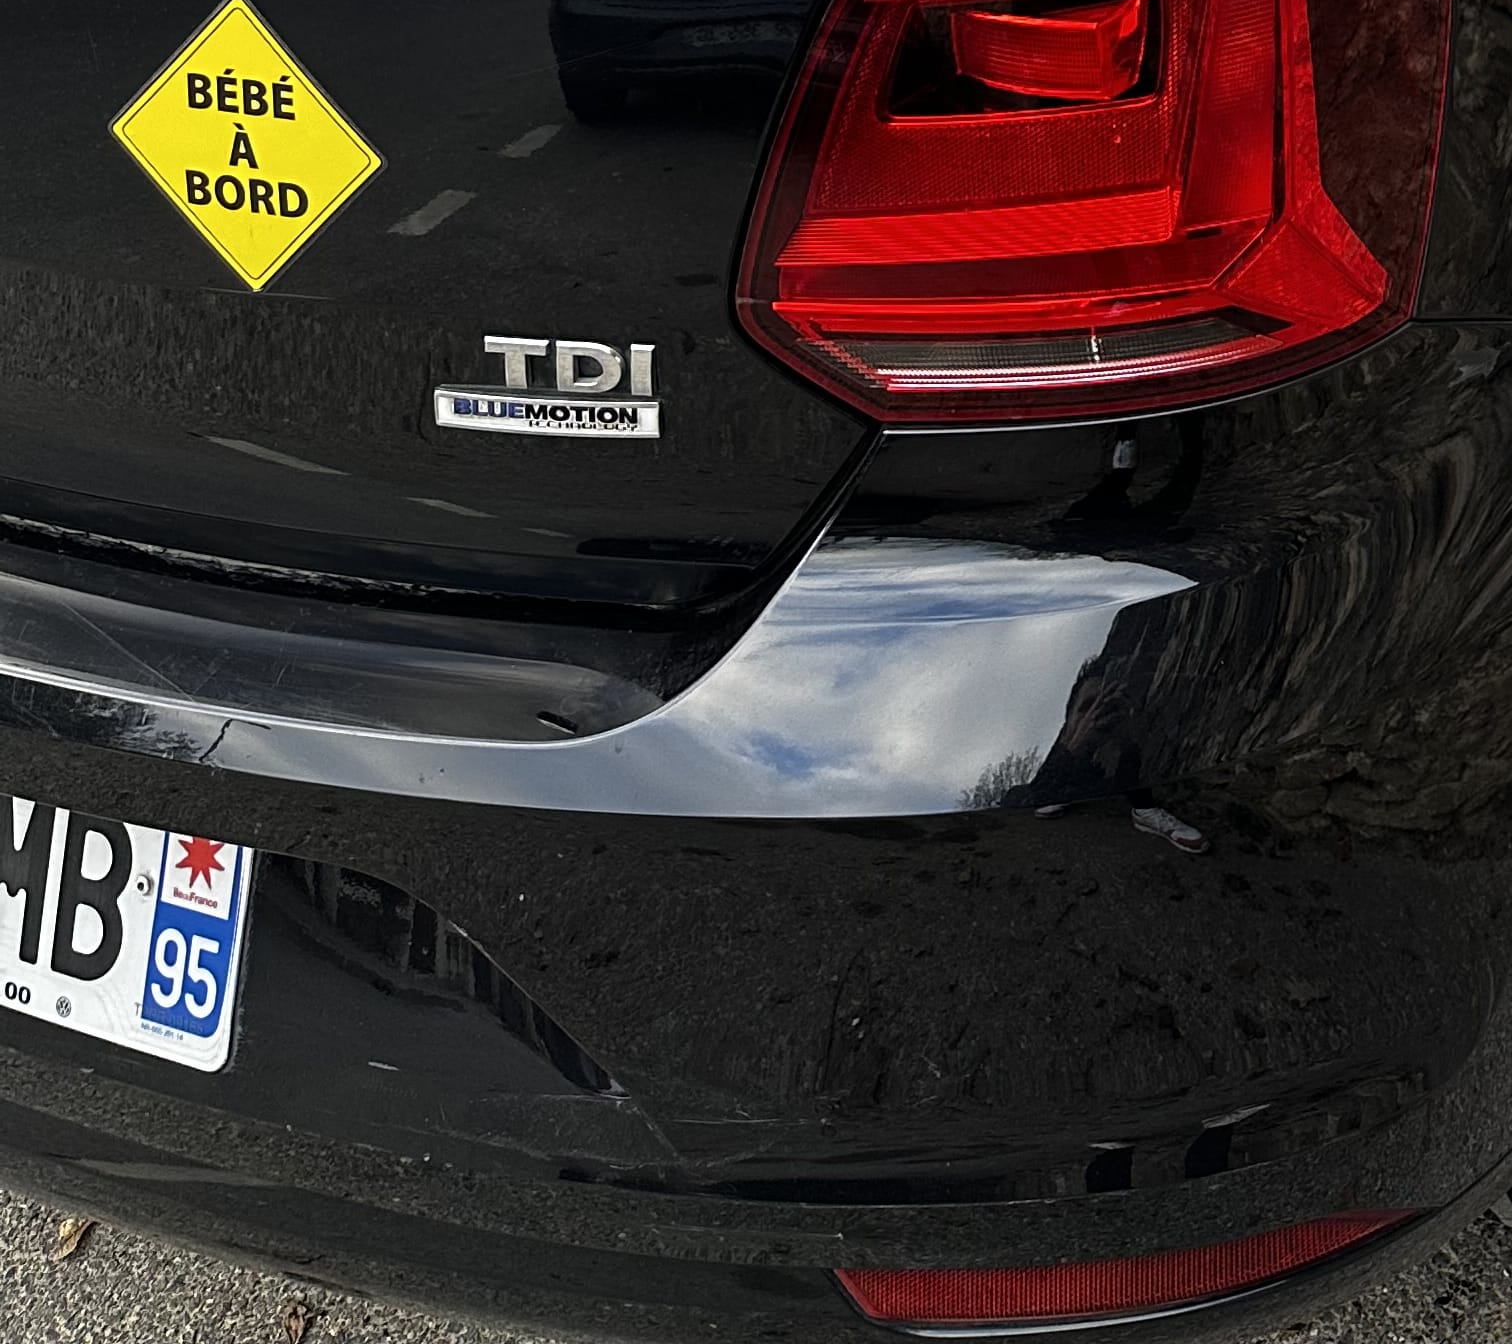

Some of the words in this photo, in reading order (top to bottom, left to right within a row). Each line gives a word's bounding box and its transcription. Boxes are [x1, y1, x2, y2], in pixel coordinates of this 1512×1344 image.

[187, 68, 295, 121] BÉBÉ
[229, 122, 259, 169] À
[185, 169, 309, 218] BORD
[484, 335, 656, 396] TDI
[453, 398, 638, 424] BLUEMOTION
[0, 794, 133, 981] MB
[4, 981, 31, 1004] 00
[150, 927, 221, 1019] 95
